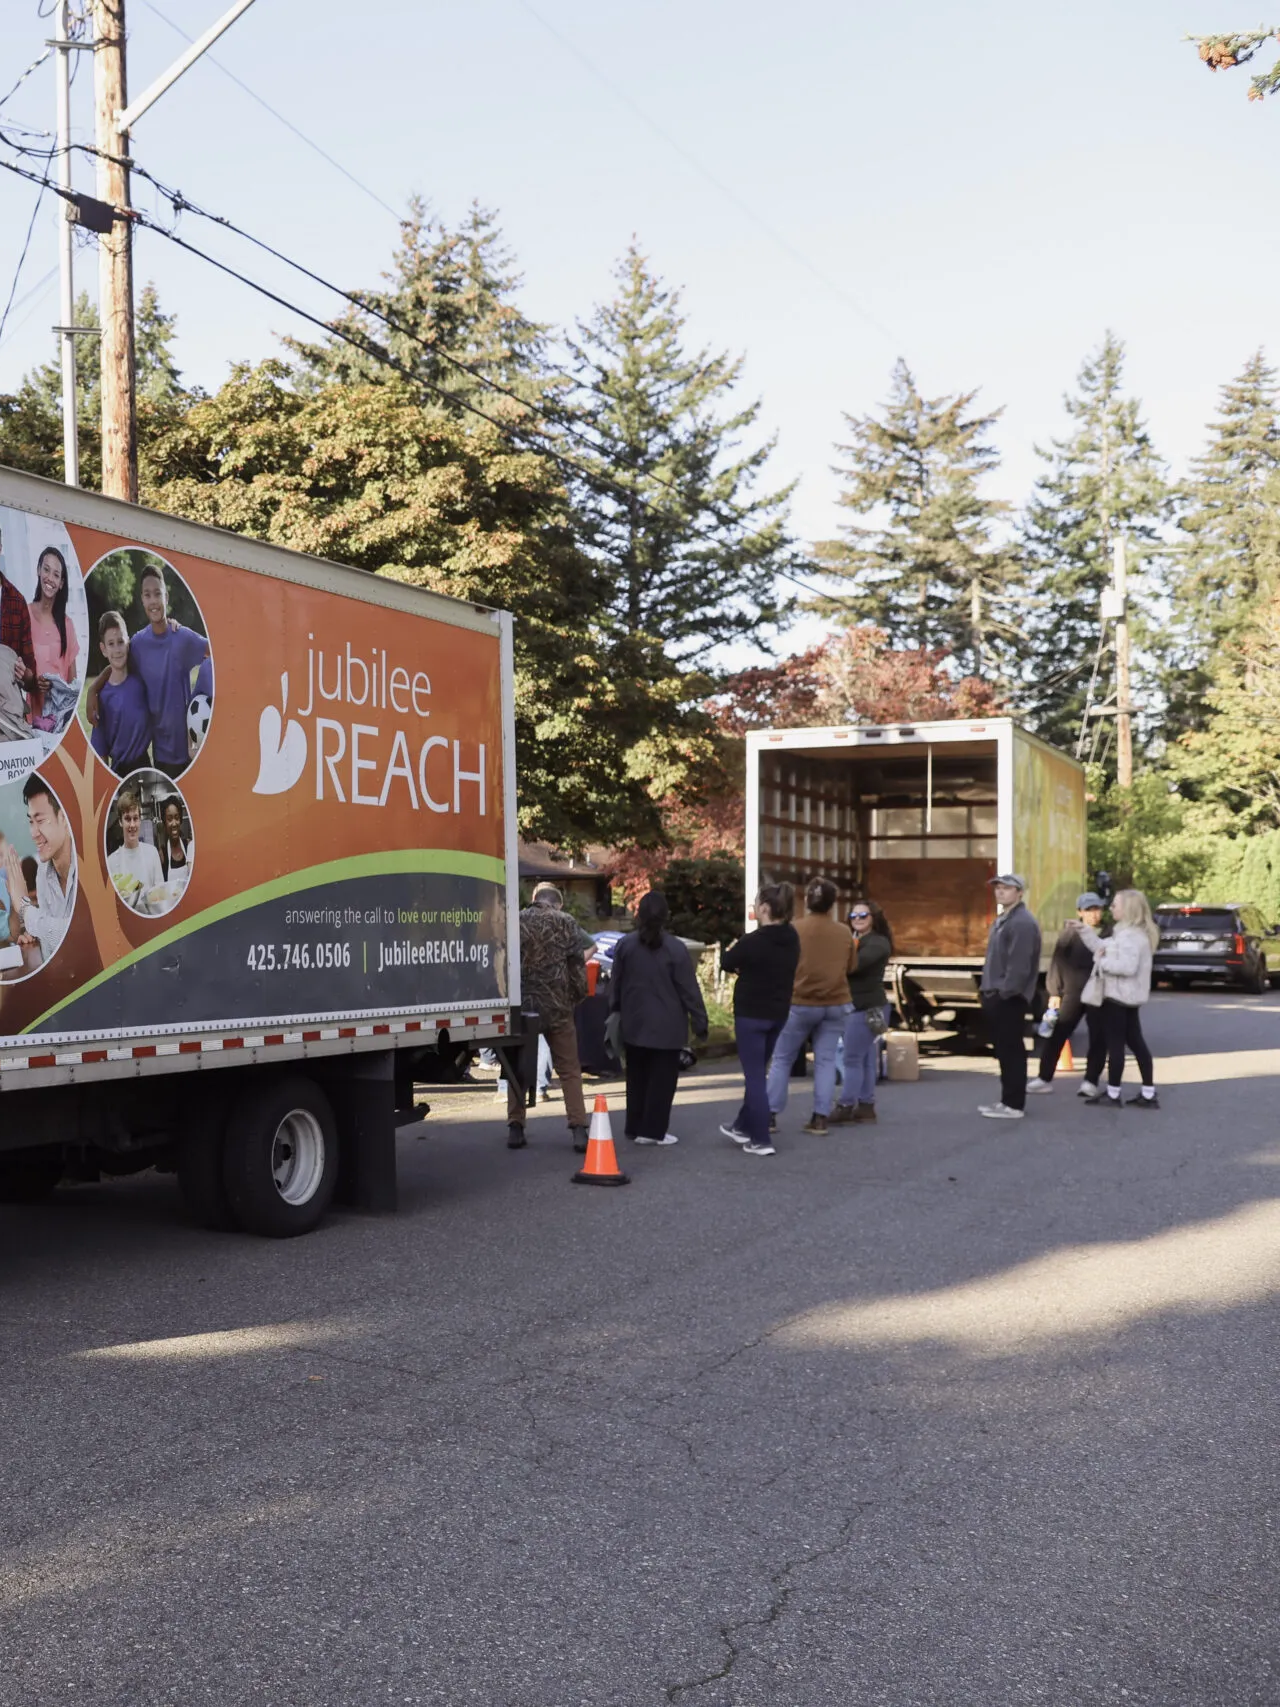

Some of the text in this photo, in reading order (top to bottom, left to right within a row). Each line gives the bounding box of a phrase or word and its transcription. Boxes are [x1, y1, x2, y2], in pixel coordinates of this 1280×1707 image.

[297, 632, 431, 717] jubilee
[316, 716, 486, 816] REACH
[285, 906, 483, 928] answering the call to love our neighbor
[246, 940, 489, 972] 425.746.0506 JubileeREACH.org
